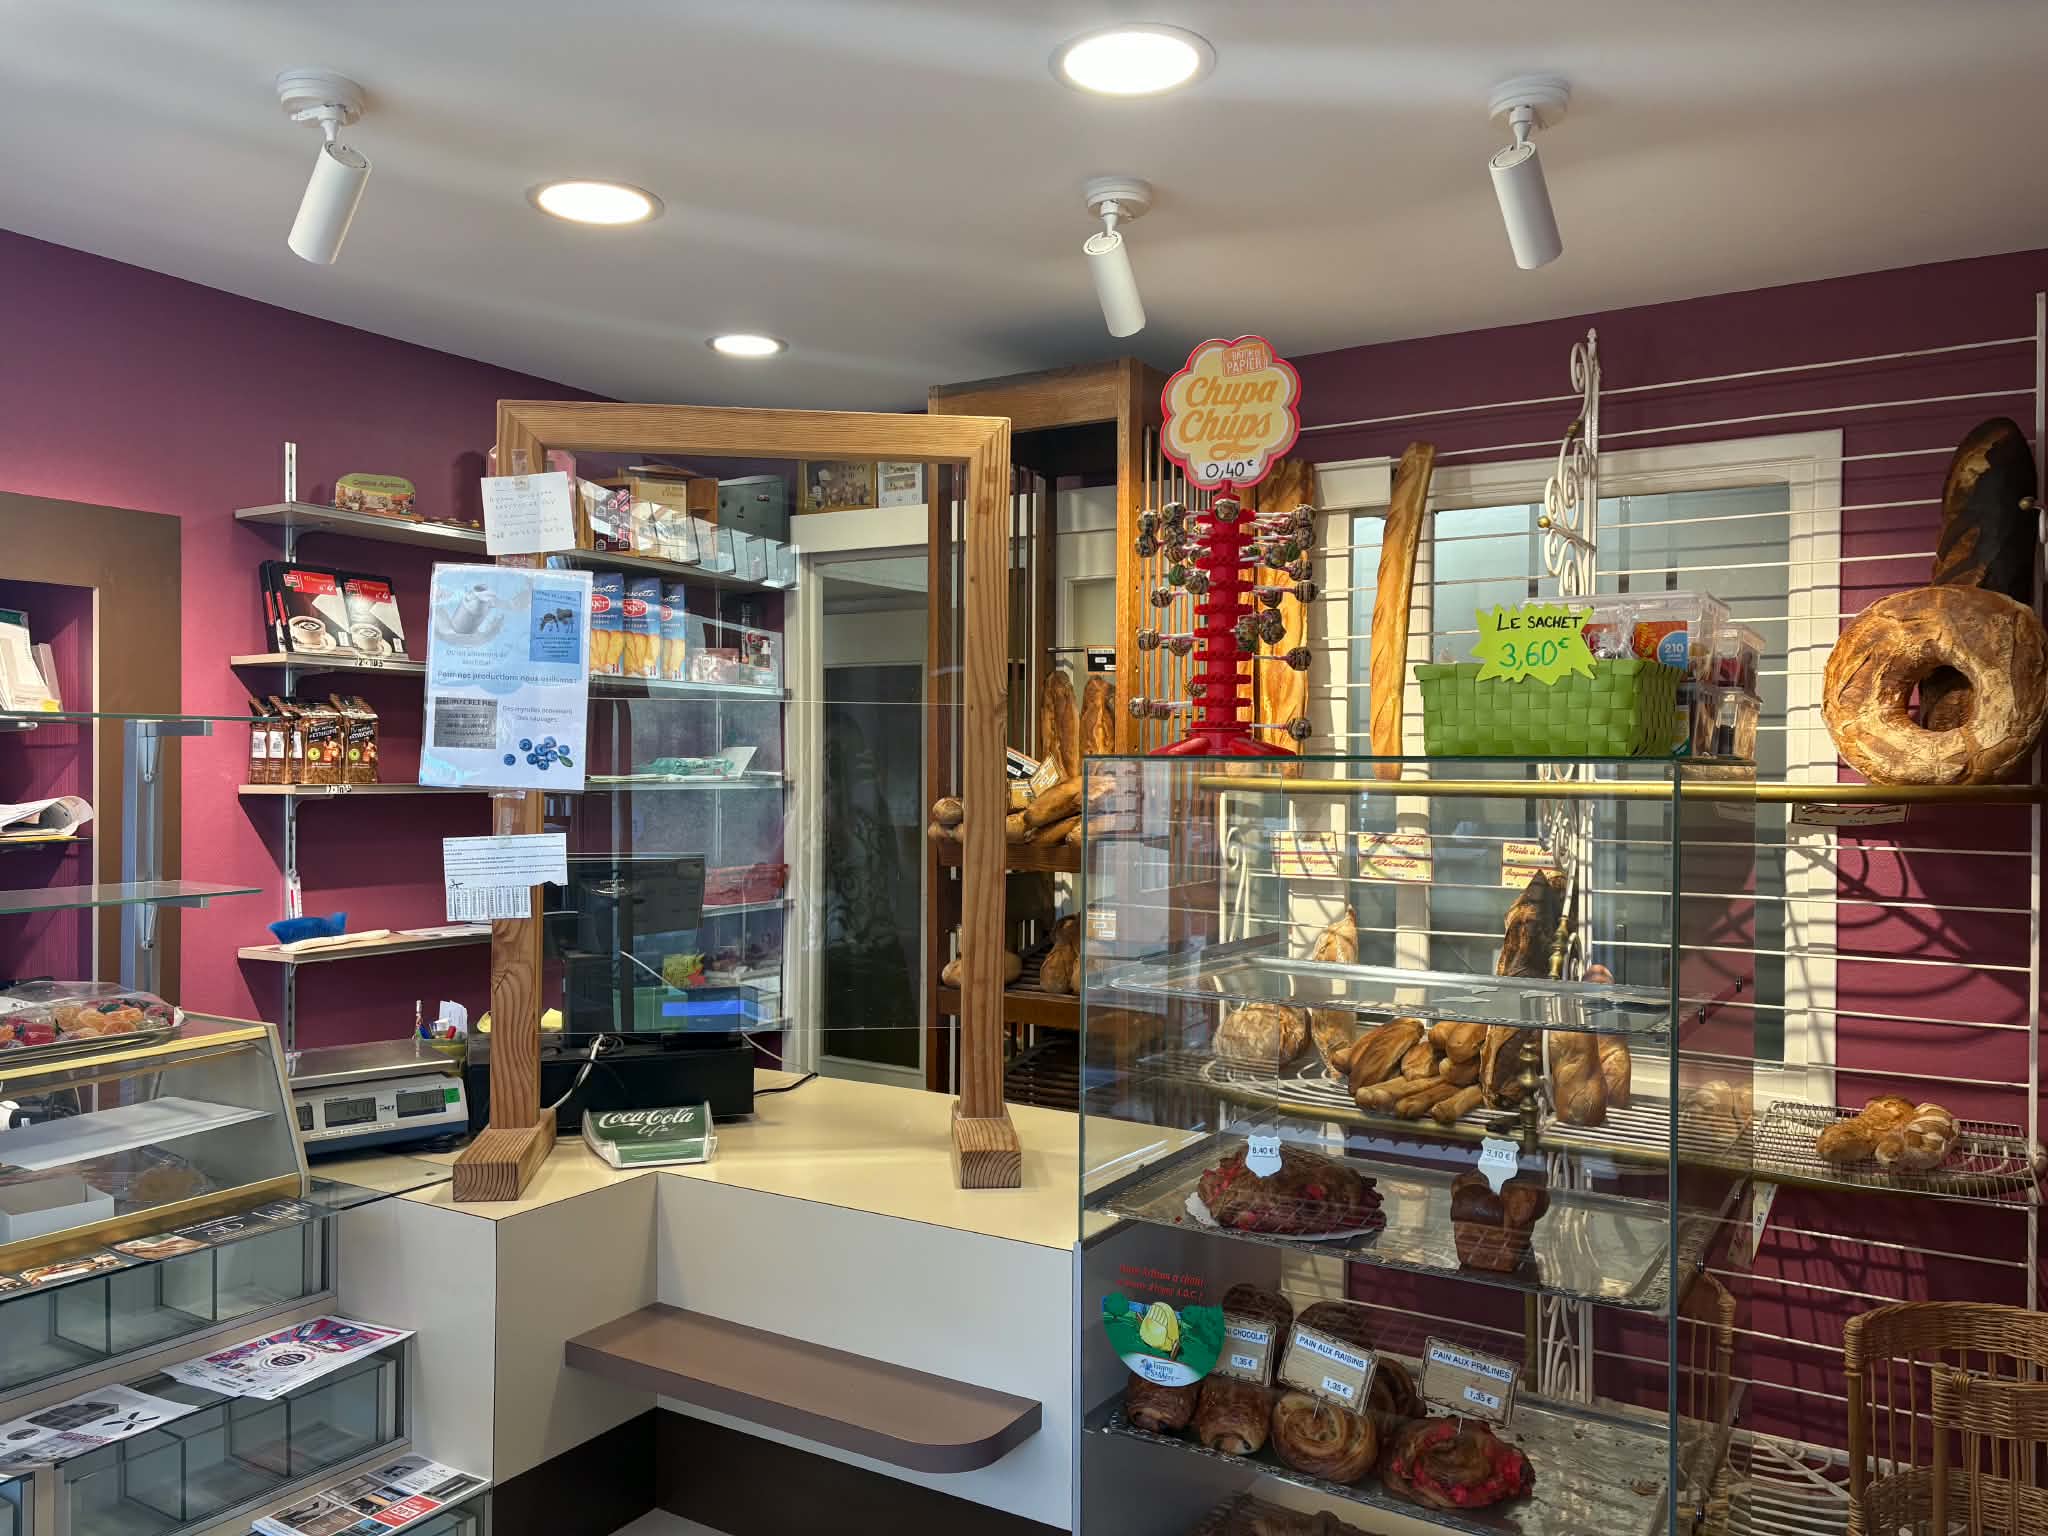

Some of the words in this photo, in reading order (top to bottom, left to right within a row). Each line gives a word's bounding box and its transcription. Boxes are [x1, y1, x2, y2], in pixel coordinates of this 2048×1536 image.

[1185, 376, 1279, 414] Chupa
[1179, 408, 1272, 458] Chups
[1497, 613, 1520, 631] LE
[1527, 615, 1586, 630] SACHET
[472, 672, 518, 682] productions
[1232, 1328, 1267, 1342] CHOCOLAT
[1299, 1336, 1317, 1351] PAIN
[1317, 1343, 1334, 1356] AUX
[1334, 1349, 1365, 1368] RAISINS
[1433, 1350, 1451, 1361] PAIN
[1452, 1356, 1470, 1368] AUX
[1470, 1360, 1511, 1379] PRALINES
